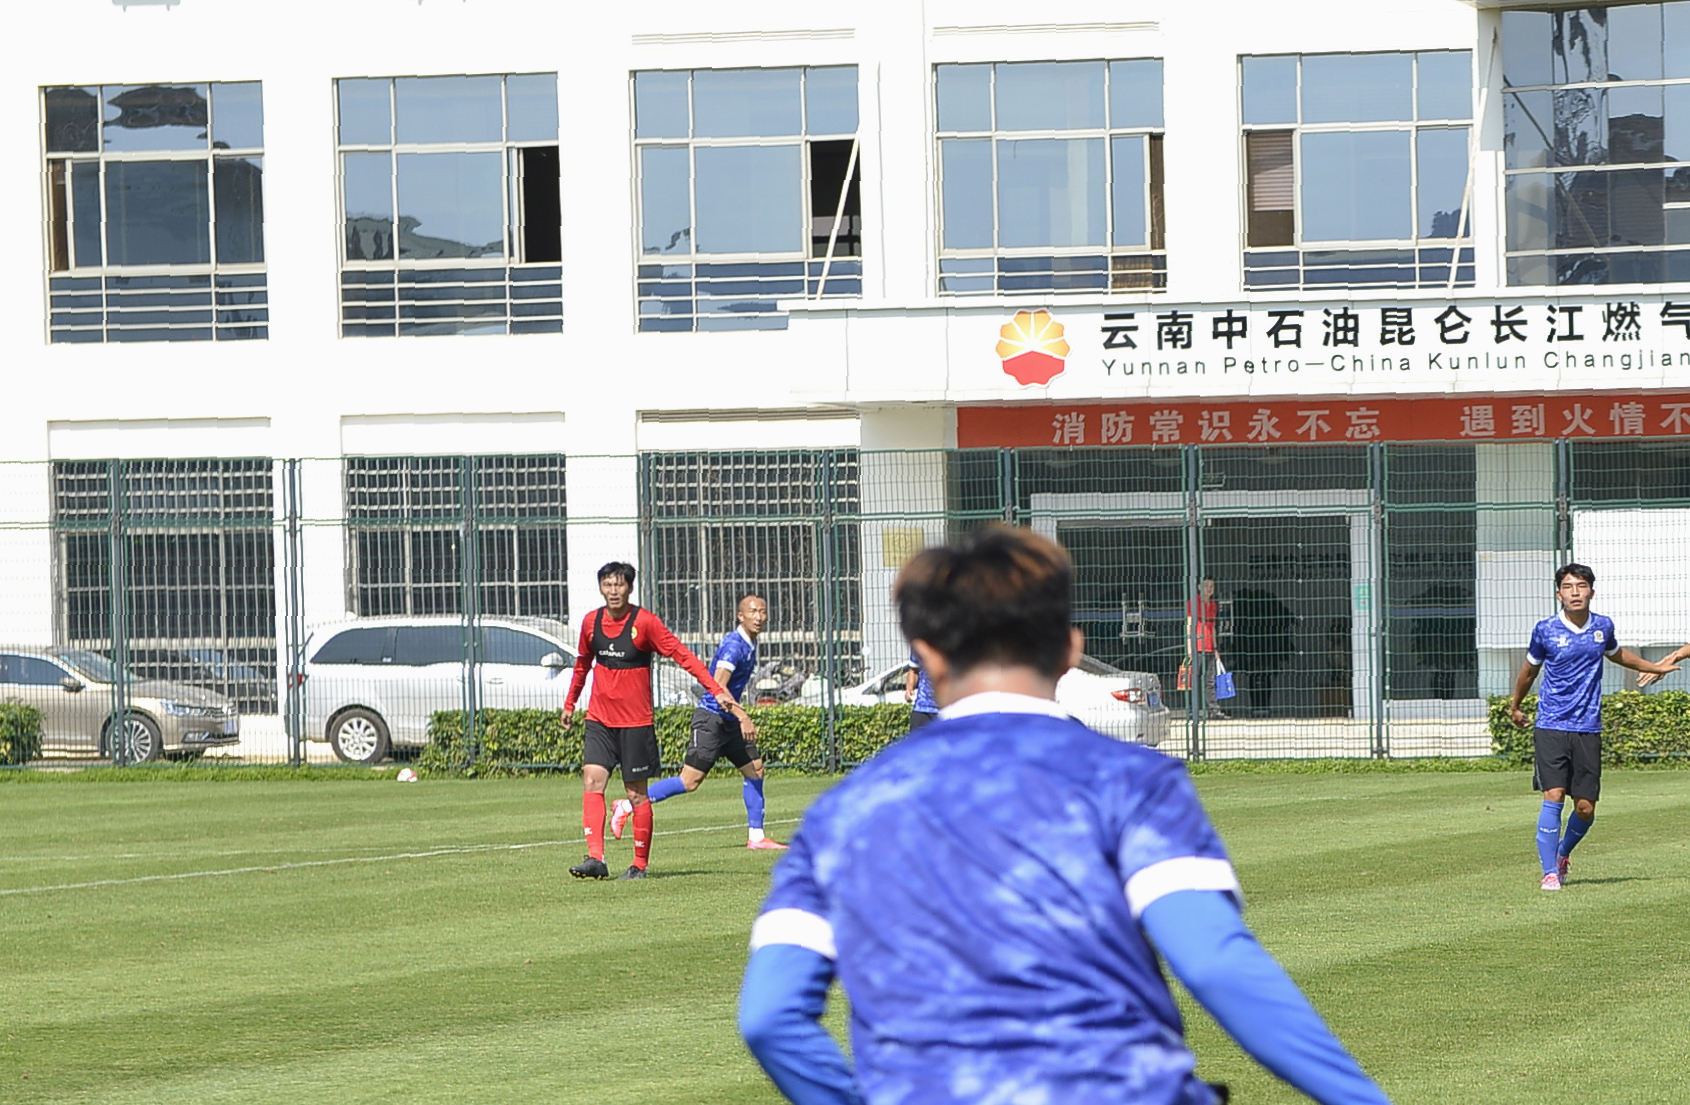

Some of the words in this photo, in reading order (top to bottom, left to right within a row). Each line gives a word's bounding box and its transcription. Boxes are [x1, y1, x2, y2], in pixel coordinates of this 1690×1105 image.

[1102, 359, 1206, 376] Yunnan
[1428, 352, 1526, 370] Kunlun
[1052, 408, 1380, 444] 消防常识永不忘
[598, 650, 626, 658] CATAPULT
